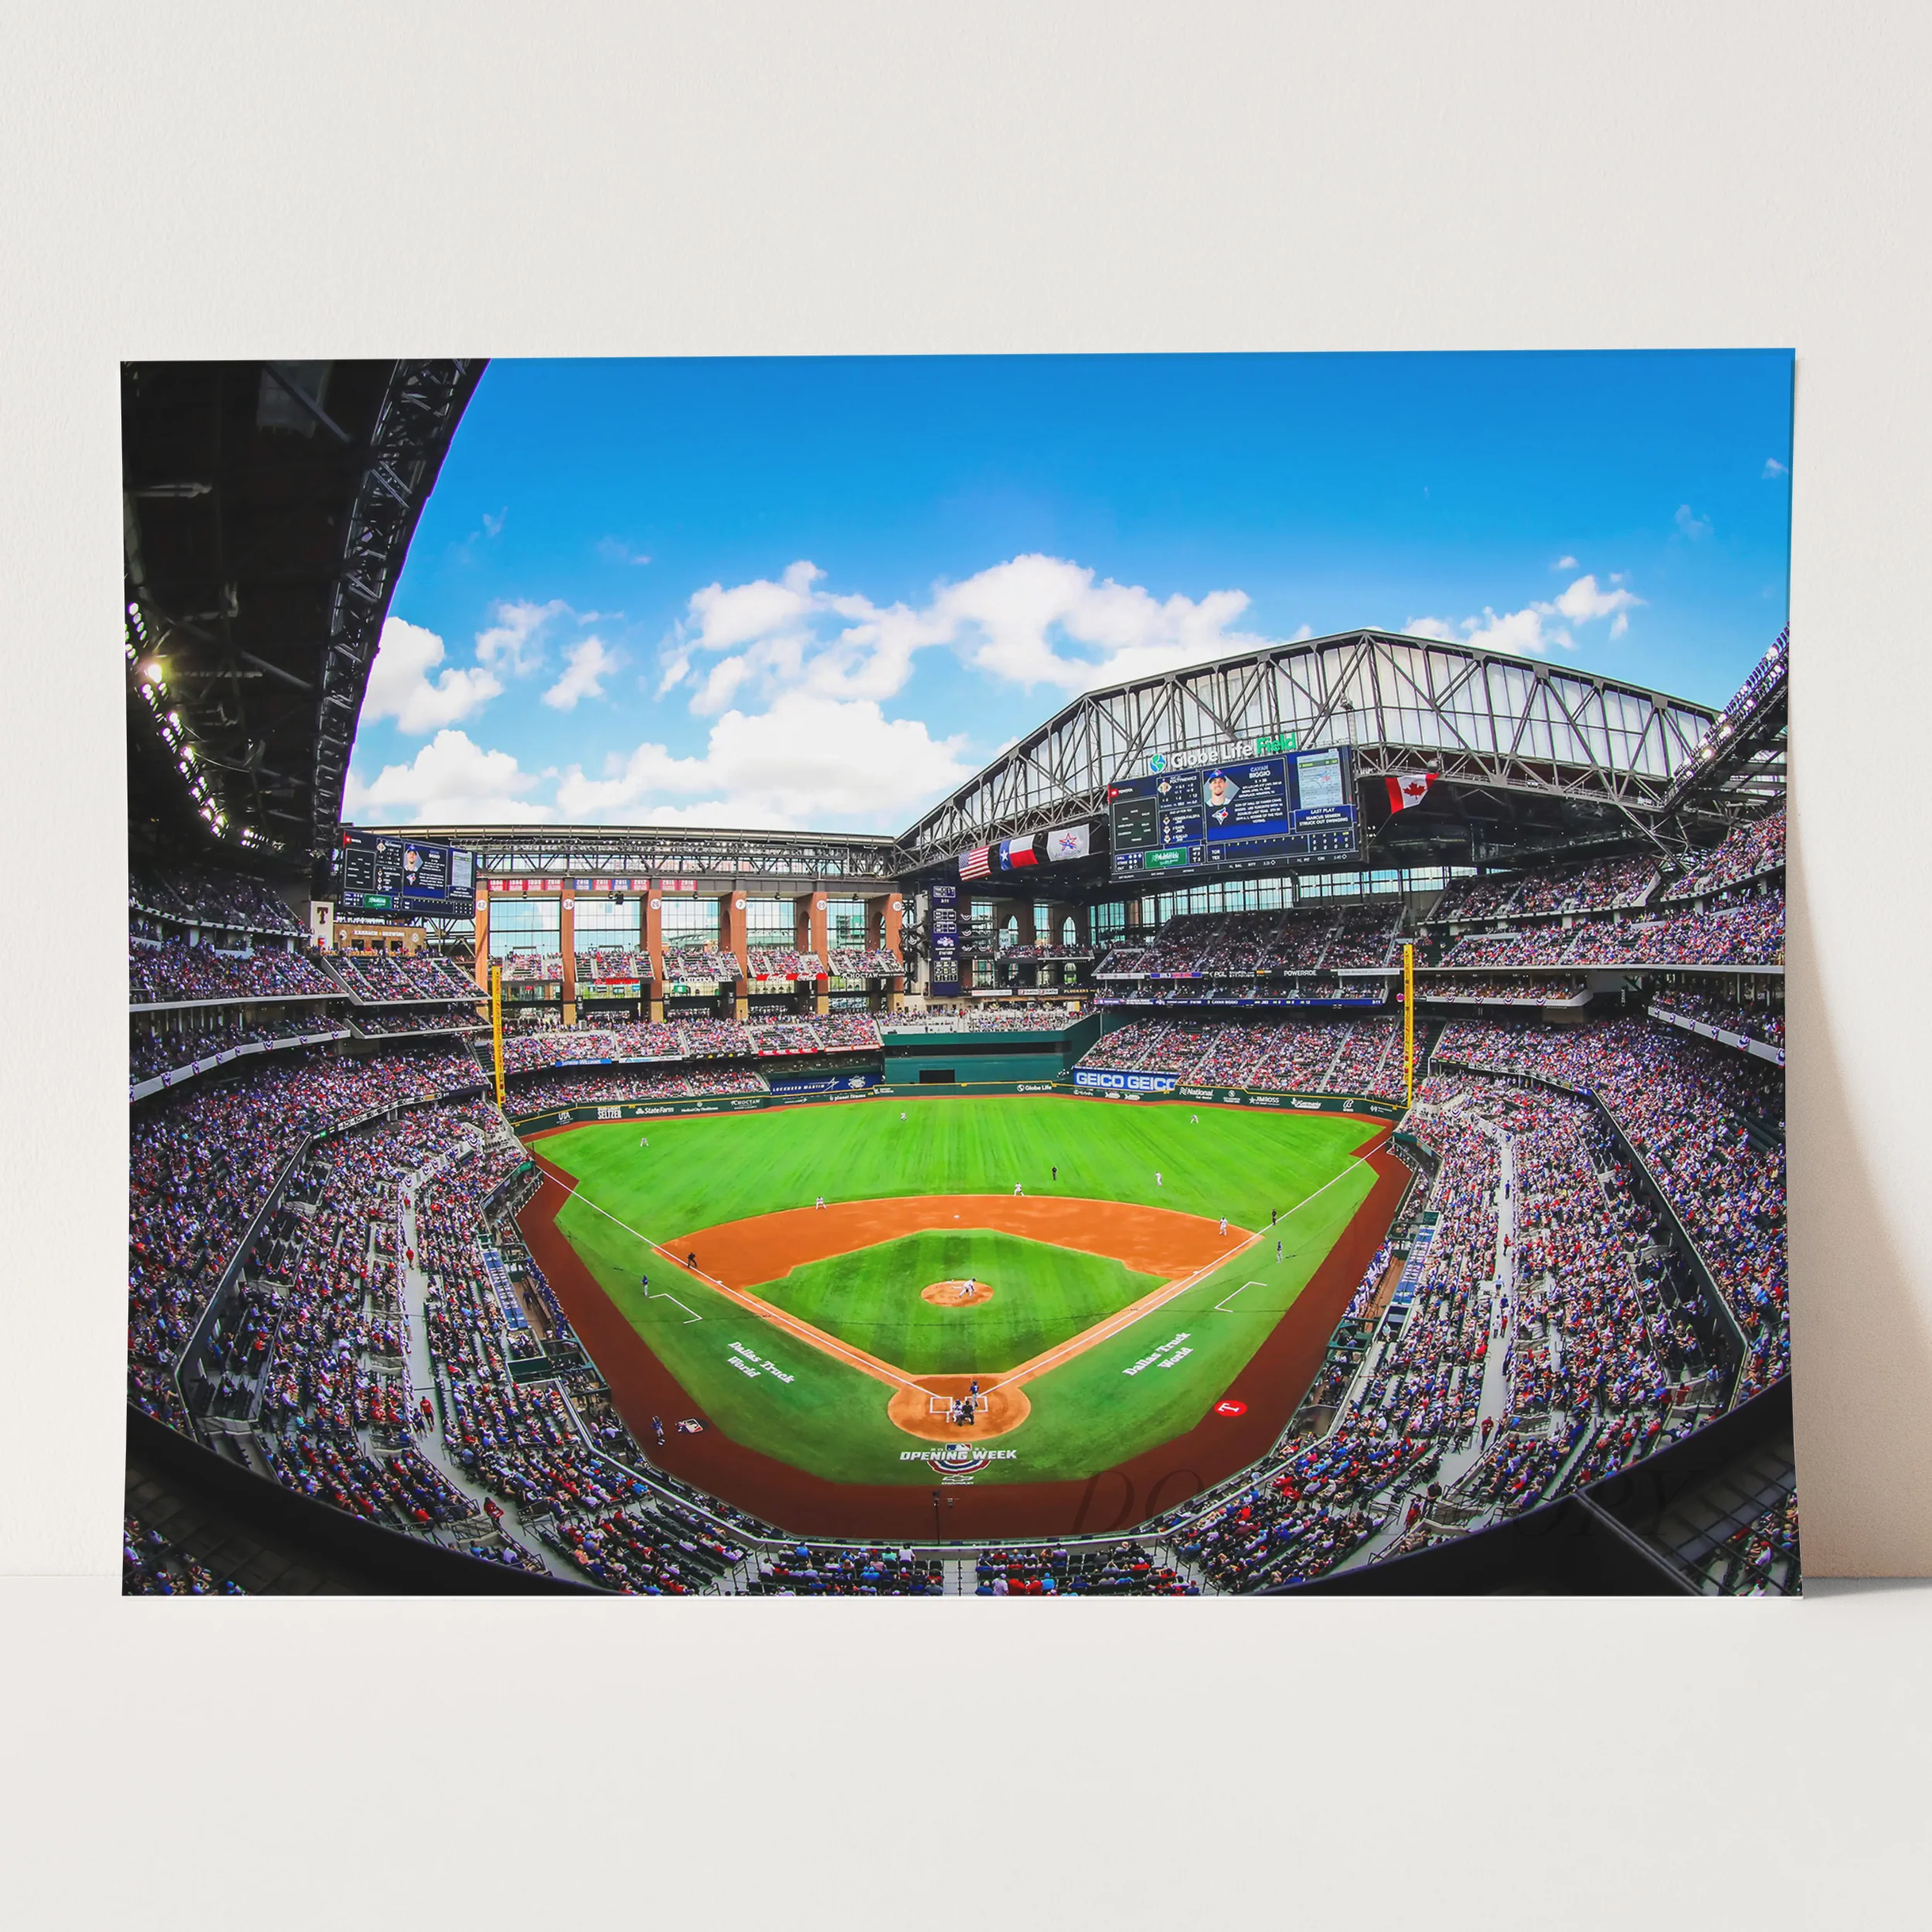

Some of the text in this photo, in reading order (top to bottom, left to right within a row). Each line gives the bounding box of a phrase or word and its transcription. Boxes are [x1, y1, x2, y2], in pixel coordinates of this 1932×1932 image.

[1171, 732, 1297, 769] Globe Life Field
[1249, 770, 1271, 779] BIGGIO
[478, 901, 486, 910] 42
[317, 906, 328, 924] T
[1076, 1072, 1124, 1088] GEICO
[1128, 1075, 1175, 1090] GEICO
[559, 1111, 570, 1121] UTA
[597, 1110, 622, 1120] SELTZER
[1122, 1332, 1192, 1376] Dallas Truck
[1157, 1347, 1193, 1368] World
[727, 1355, 761, 1378] World
[728, 1342, 795, 1383] Dallas Truck
[1218, 1402, 1240, 1413] T
[900, 1449, 1017, 1461] OPENING WEEK
